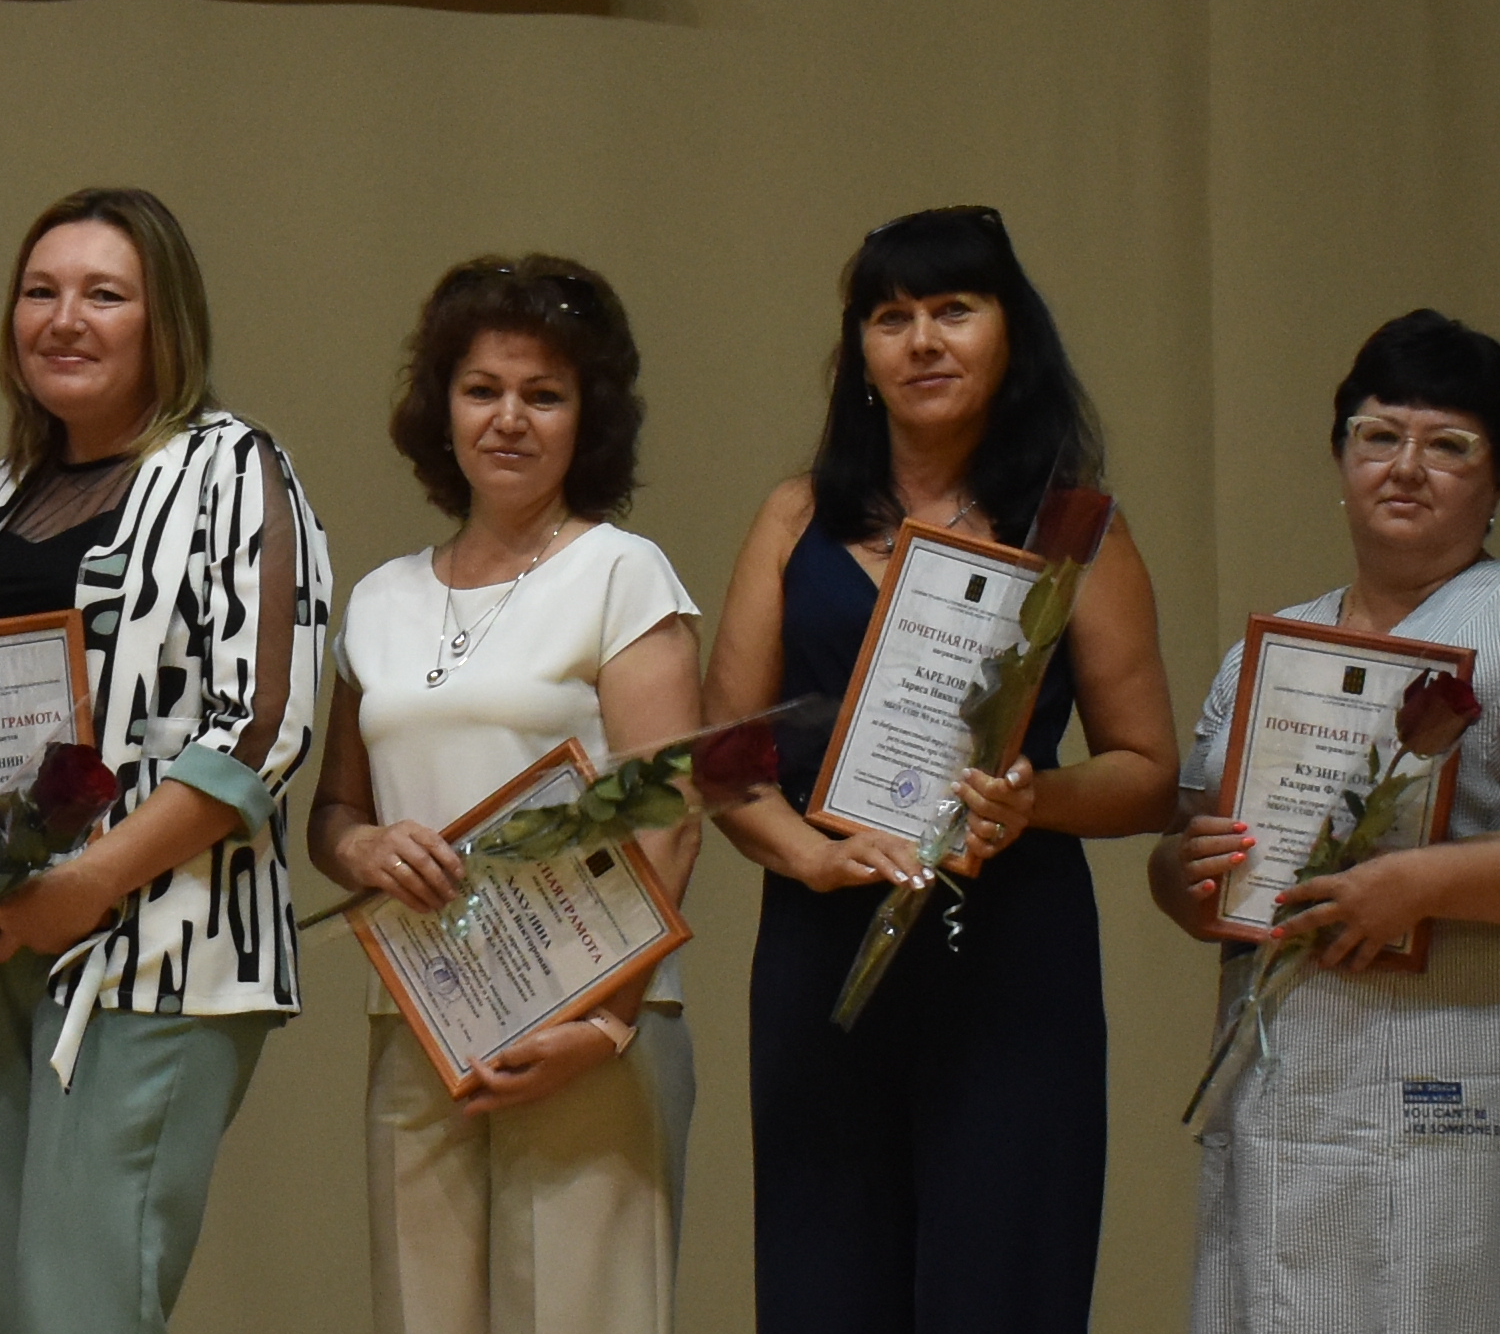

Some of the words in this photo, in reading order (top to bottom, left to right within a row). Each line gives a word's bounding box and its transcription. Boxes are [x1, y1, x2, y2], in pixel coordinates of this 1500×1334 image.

[896, 617, 963, 648] ПОЧЕТНАЯ
[914, 665, 968, 691] КАРЕЛОВ
[0, 709, 61, 729] ГРАМОТА
[1264, 715, 1349, 742] ПОЧЕТНАЯ
[504, 874, 554, 950] ХАХУЛИНА
[510, 913, 554, 978] Викторовна
[557, 895, 605, 965] ГРАМОТА
